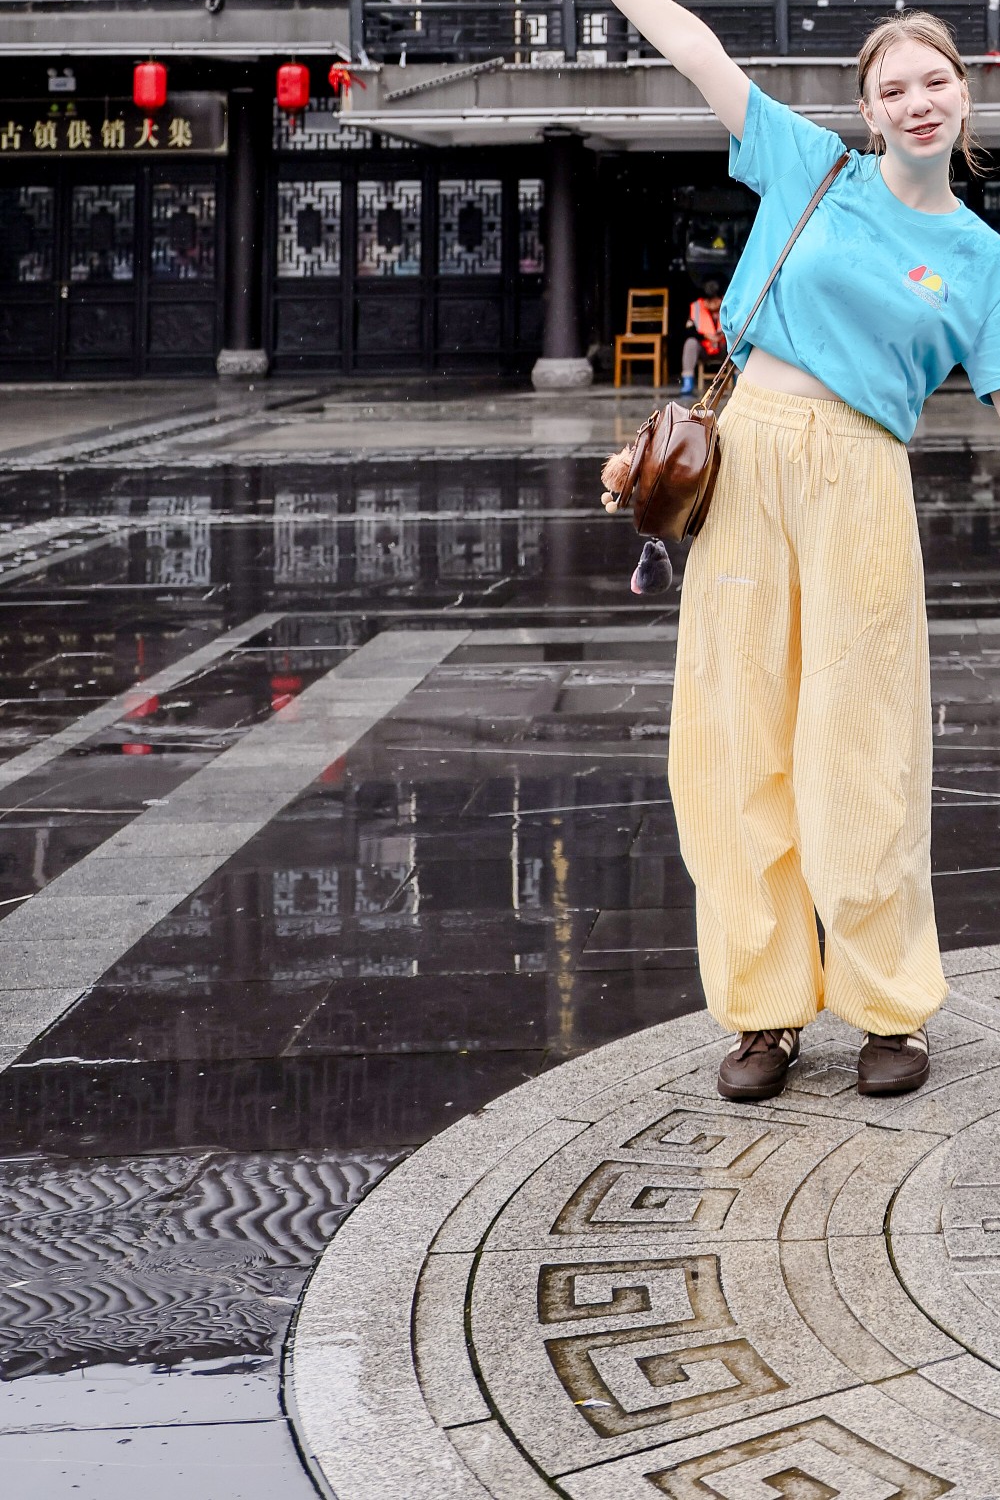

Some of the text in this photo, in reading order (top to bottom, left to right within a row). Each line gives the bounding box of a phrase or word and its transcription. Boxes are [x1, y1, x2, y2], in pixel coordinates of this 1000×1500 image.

[0, 117, 193, 150] 古镇供销大集
